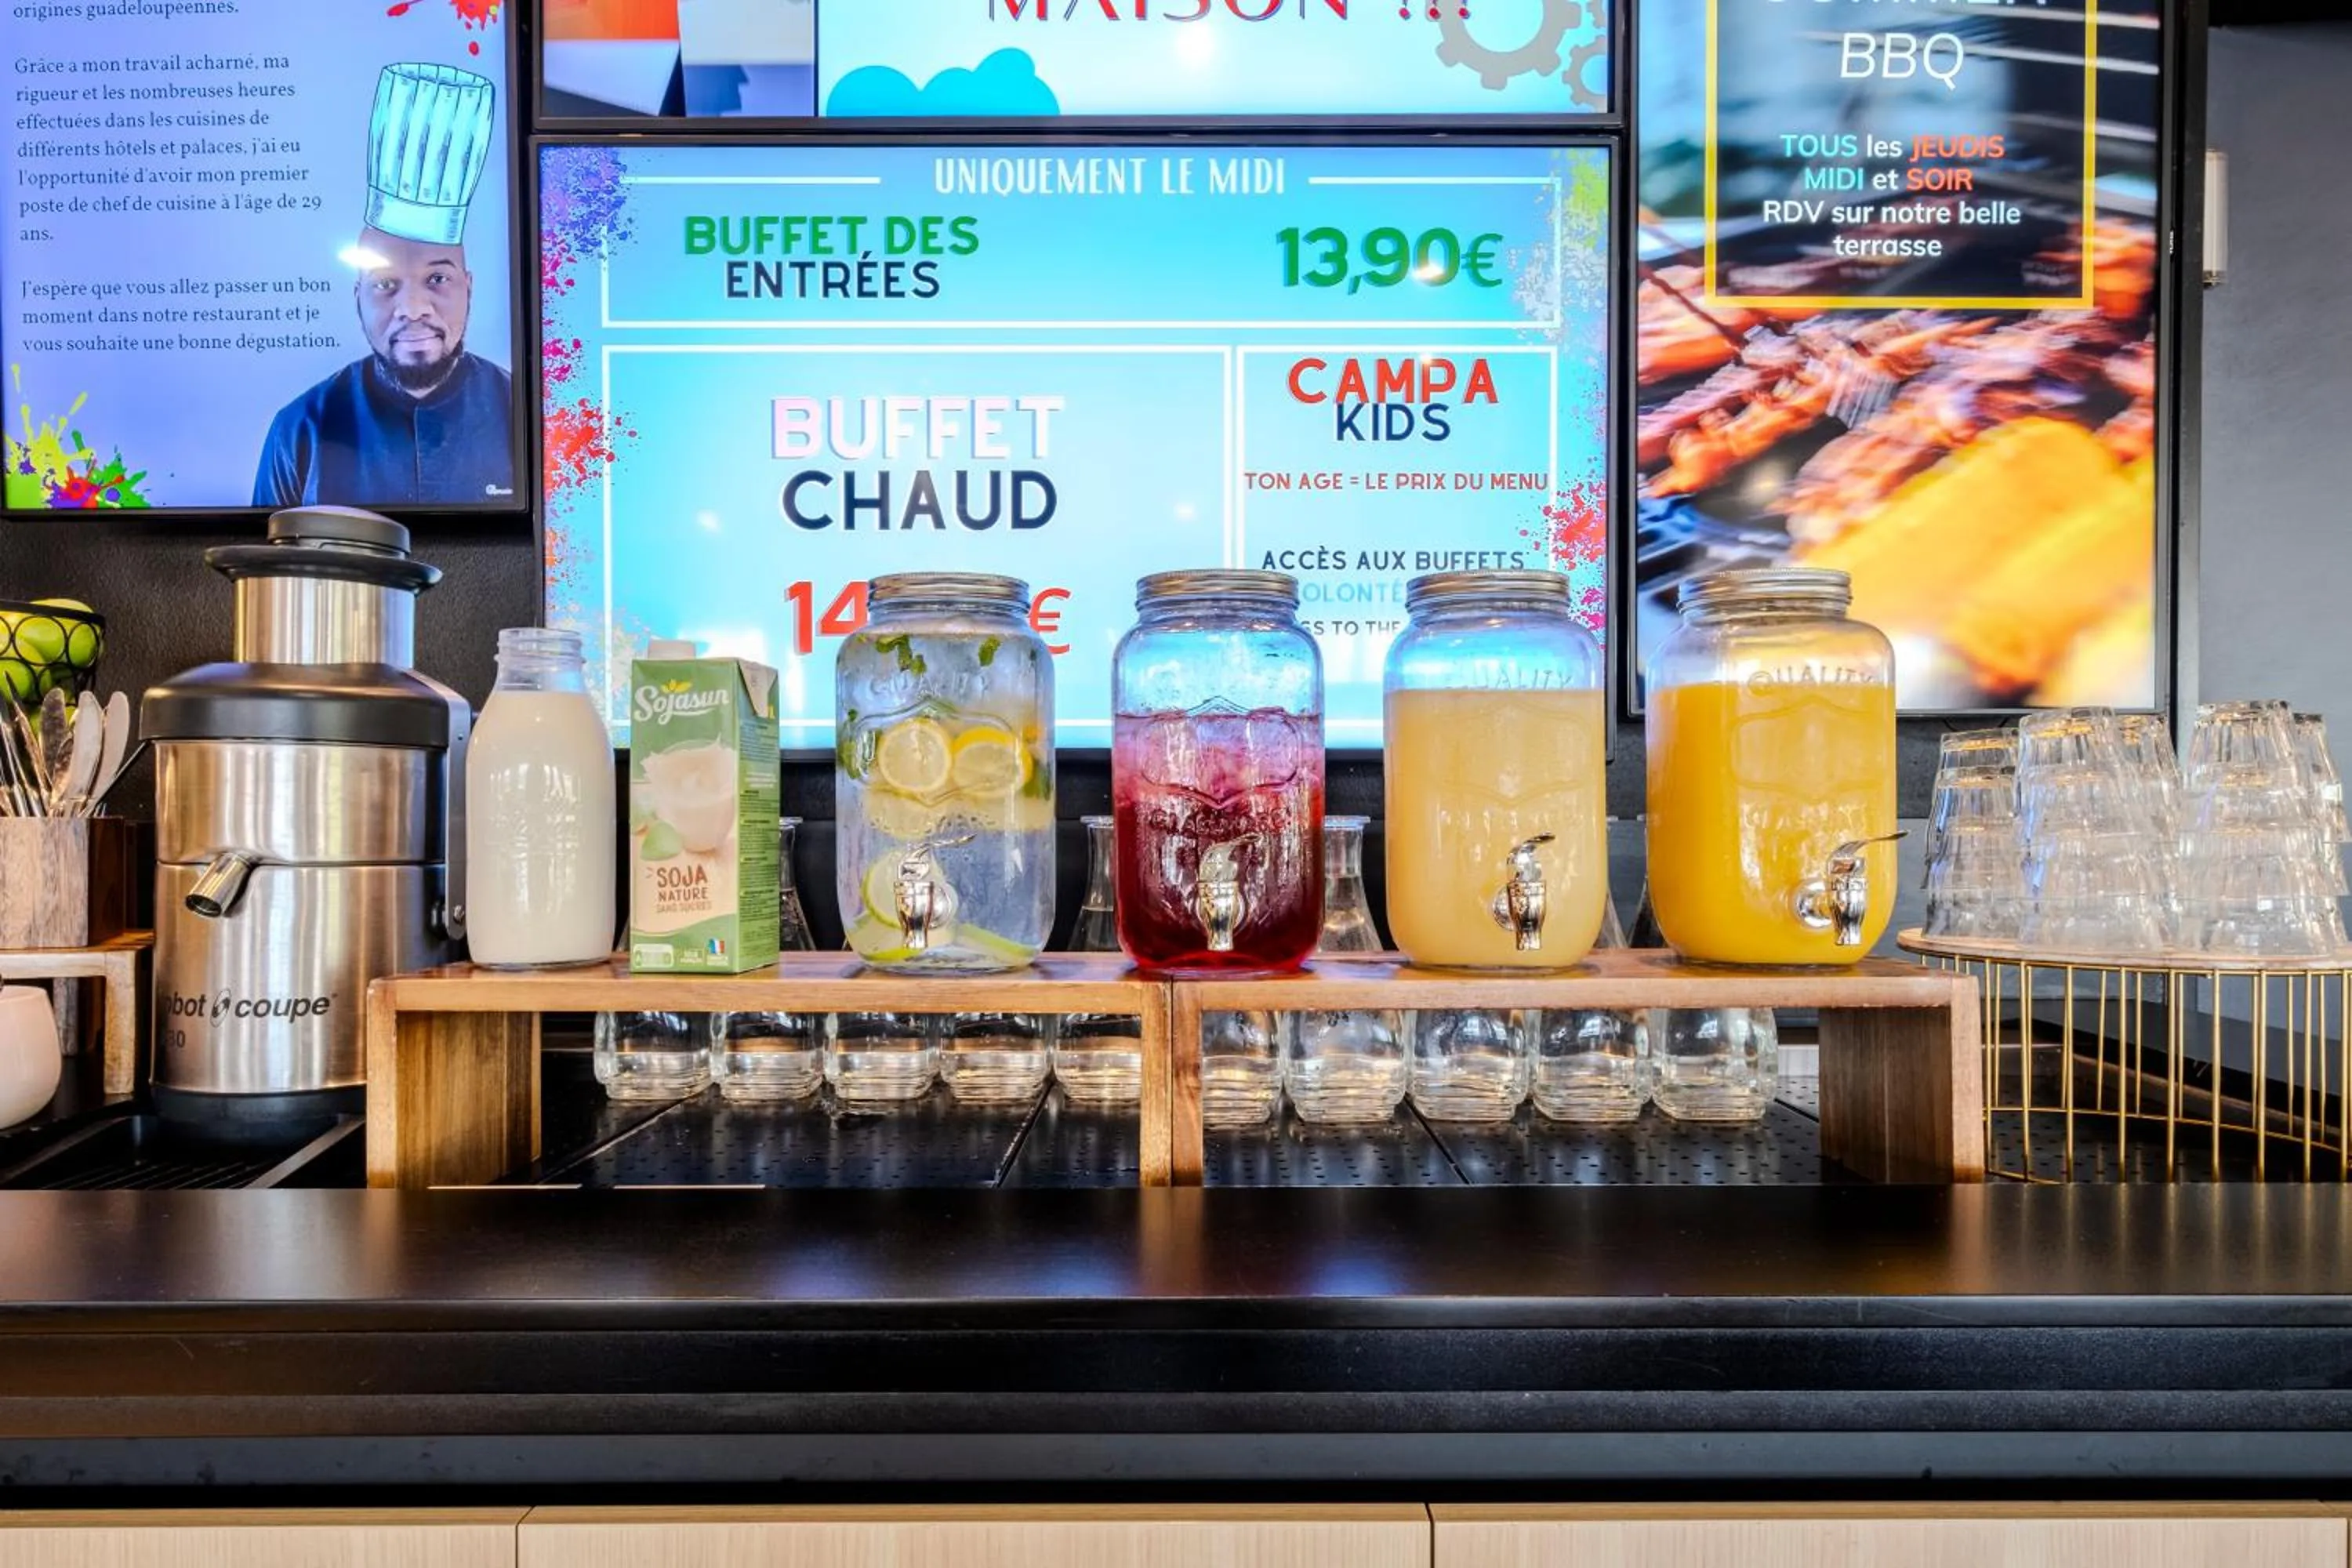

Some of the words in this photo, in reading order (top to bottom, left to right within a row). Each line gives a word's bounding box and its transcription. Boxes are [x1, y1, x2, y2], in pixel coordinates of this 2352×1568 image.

[13, 3, 82, 21] origines
[15, 57, 64, 74] Grâce
[82, 60, 121, 72] mon
[125, 54, 181, 71] travail
[263, 57, 289, 69] ma
[1840, 32, 1965, 91] BBQ
[16, 86, 78, 105] rigueur
[82, 87, 98, 100] et
[103, 84, 127, 100] les
[130, 82, 234, 100] nombreuses
[238, 82, 296, 98] heures
[16, 112, 101, 130] effectuées
[104, 112, 146, 129] dans
[150, 111, 173, 127] les
[176, 111, 245, 127] cuisines
[249, 109, 270, 125] de
[17, 140, 100, 158] différents
[104, 139, 157, 156] hôtels
[160, 140, 177, 155] et
[180, 138, 248, 159] palaces,
[252, 137, 278, 155] j'ai
[279, 142, 300, 154] eu
[1780, 134, 1858, 158] TOUS
[1865, 134, 1903, 158] les
[1908, 134, 2005, 162] JEUDIS
[19, 167, 130, 190] l'opportunité
[133, 166, 193, 183] d'avoir
[196, 169, 235, 182] mon
[240, 166, 309, 187] premier
[935, 158, 1146, 197] UNIQUEMENT
[1162, 158, 1194, 194] LE
[1208, 158, 1285, 194] MIDI
[1804, 169, 1864, 191] MIDI
[1872, 170, 1899, 191] et
[1906, 168, 1973, 191] SOIR
[20, 196, 64, 217] poste
[68, 195, 89, 212] de
[92, 194, 132, 212] chef
[132, 195, 152, 212] de
[156, 194, 216, 211] cuisine
[220, 194, 230, 210] à
[234, 192, 272, 214] l'âge
[276, 192, 297, 209] de
[302, 196, 322, 211] 29
[1763, 201, 1824, 224] RDV
[1831, 208, 1874, 225] sur
[1882, 202, 1951, 225] notre
[1958, 201, 2021, 225] belle
[20, 229, 53, 241] ans.
[684, 216, 868, 255] BUFFET
[886, 216, 980, 255] DES
[1833, 235, 1942, 257] terrasse
[1276, 225, 1504, 296] 13,90€
[726, 250, 941, 299] ENTRÉES
[22, 280, 89, 300] J'espère
[92, 283, 122, 300] que
[126, 281, 165, 295] vous
[169, 278, 209, 295] allez
[214, 281, 268, 299] passer
[271, 280, 294, 293] un
[298, 277, 331, 293] bon
[23, 310, 93, 324] moment
[98, 307, 139, 323] dans
[142, 308, 188, 323] notre
[193, 307, 282, 323] restaurant
[285, 307, 300, 321] et
[305, 306, 320, 325] je
[23, 339, 64, 352] vous
[66, 335, 139, 351] souhaite
[143, 337, 174, 350] une
[178, 332, 231, 350] bonne
[235, 332, 340, 354] dégustation.
[1286, 357, 1500, 404] CAMPA
[771, 397, 1065, 460] BUFFET
[1336, 402, 1451, 442] KIDS
[1244, 472, 1291, 491] TON
[1298, 473, 1344, 491] AGE
[1365, 472, 1389, 491] LE
[1396, 472, 1446, 491] PRIX
[1454, 472, 1484, 491] DU
[1490, 472, 1548, 491] MENU
[782, 470, 1058, 531] CHAUD
[1261, 546, 1347, 570] ACCÈS
[1356, 550, 1406, 570] AUX
[1414, 550, 1525, 571] BUFFETS
[1301, 577, 1403, 603] OLONTÉ
[1331, 620, 1359, 636] TO
[633, 684, 730, 725] Sojasun
[656, 863, 709, 888] SOJA
[658, 887, 710, 902] NATURE
[234, 995, 331, 1024] coupe
